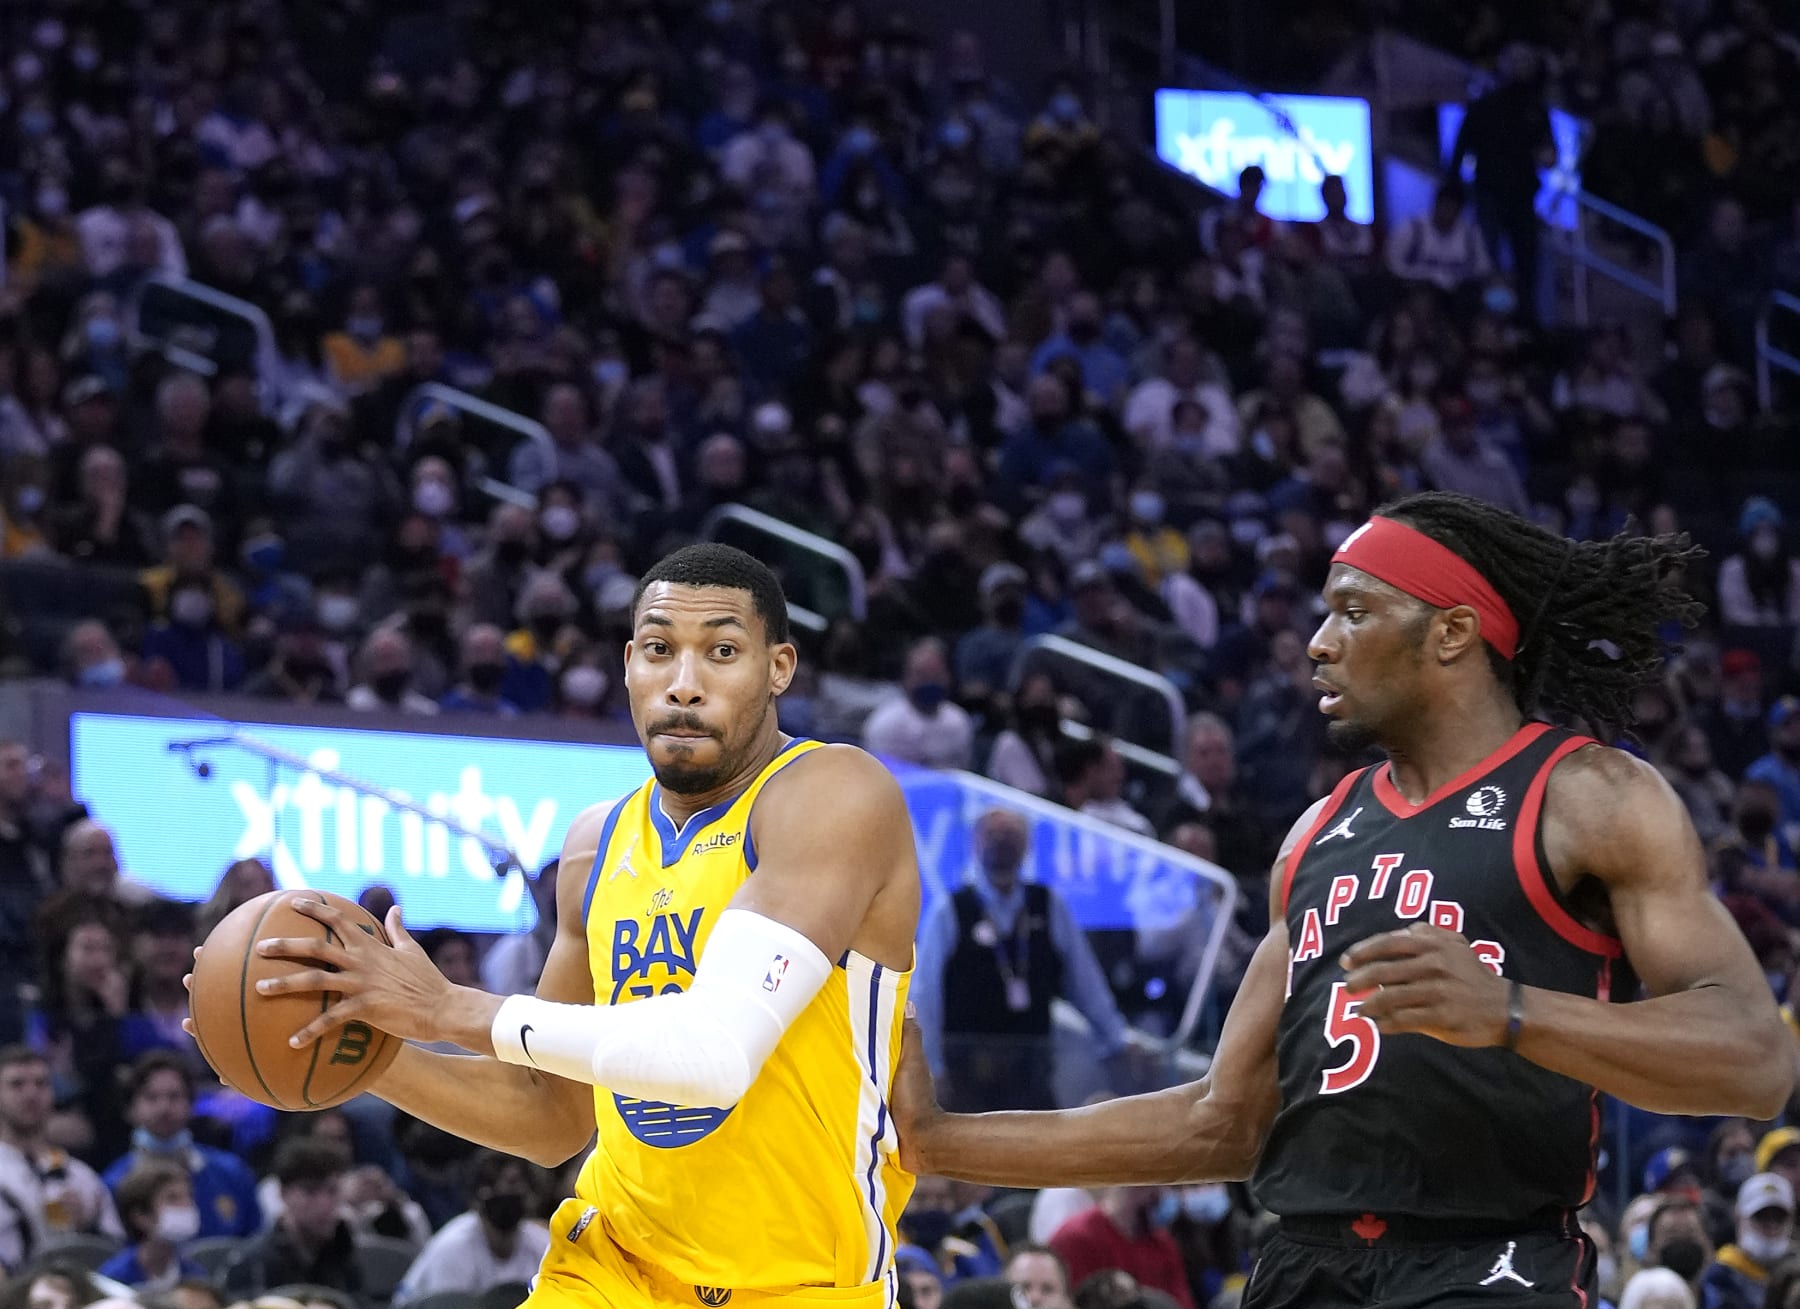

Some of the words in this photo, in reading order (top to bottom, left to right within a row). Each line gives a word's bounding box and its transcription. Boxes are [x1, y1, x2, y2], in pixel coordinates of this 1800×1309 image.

[230, 748, 557, 914] xfinity
[1448, 817, 1477, 829] Sun
[1477, 817, 1506, 831] Life
[646, 887, 674, 917] The
[611, 906, 705, 983] BAY
[1317, 981, 1381, 1095] 5
